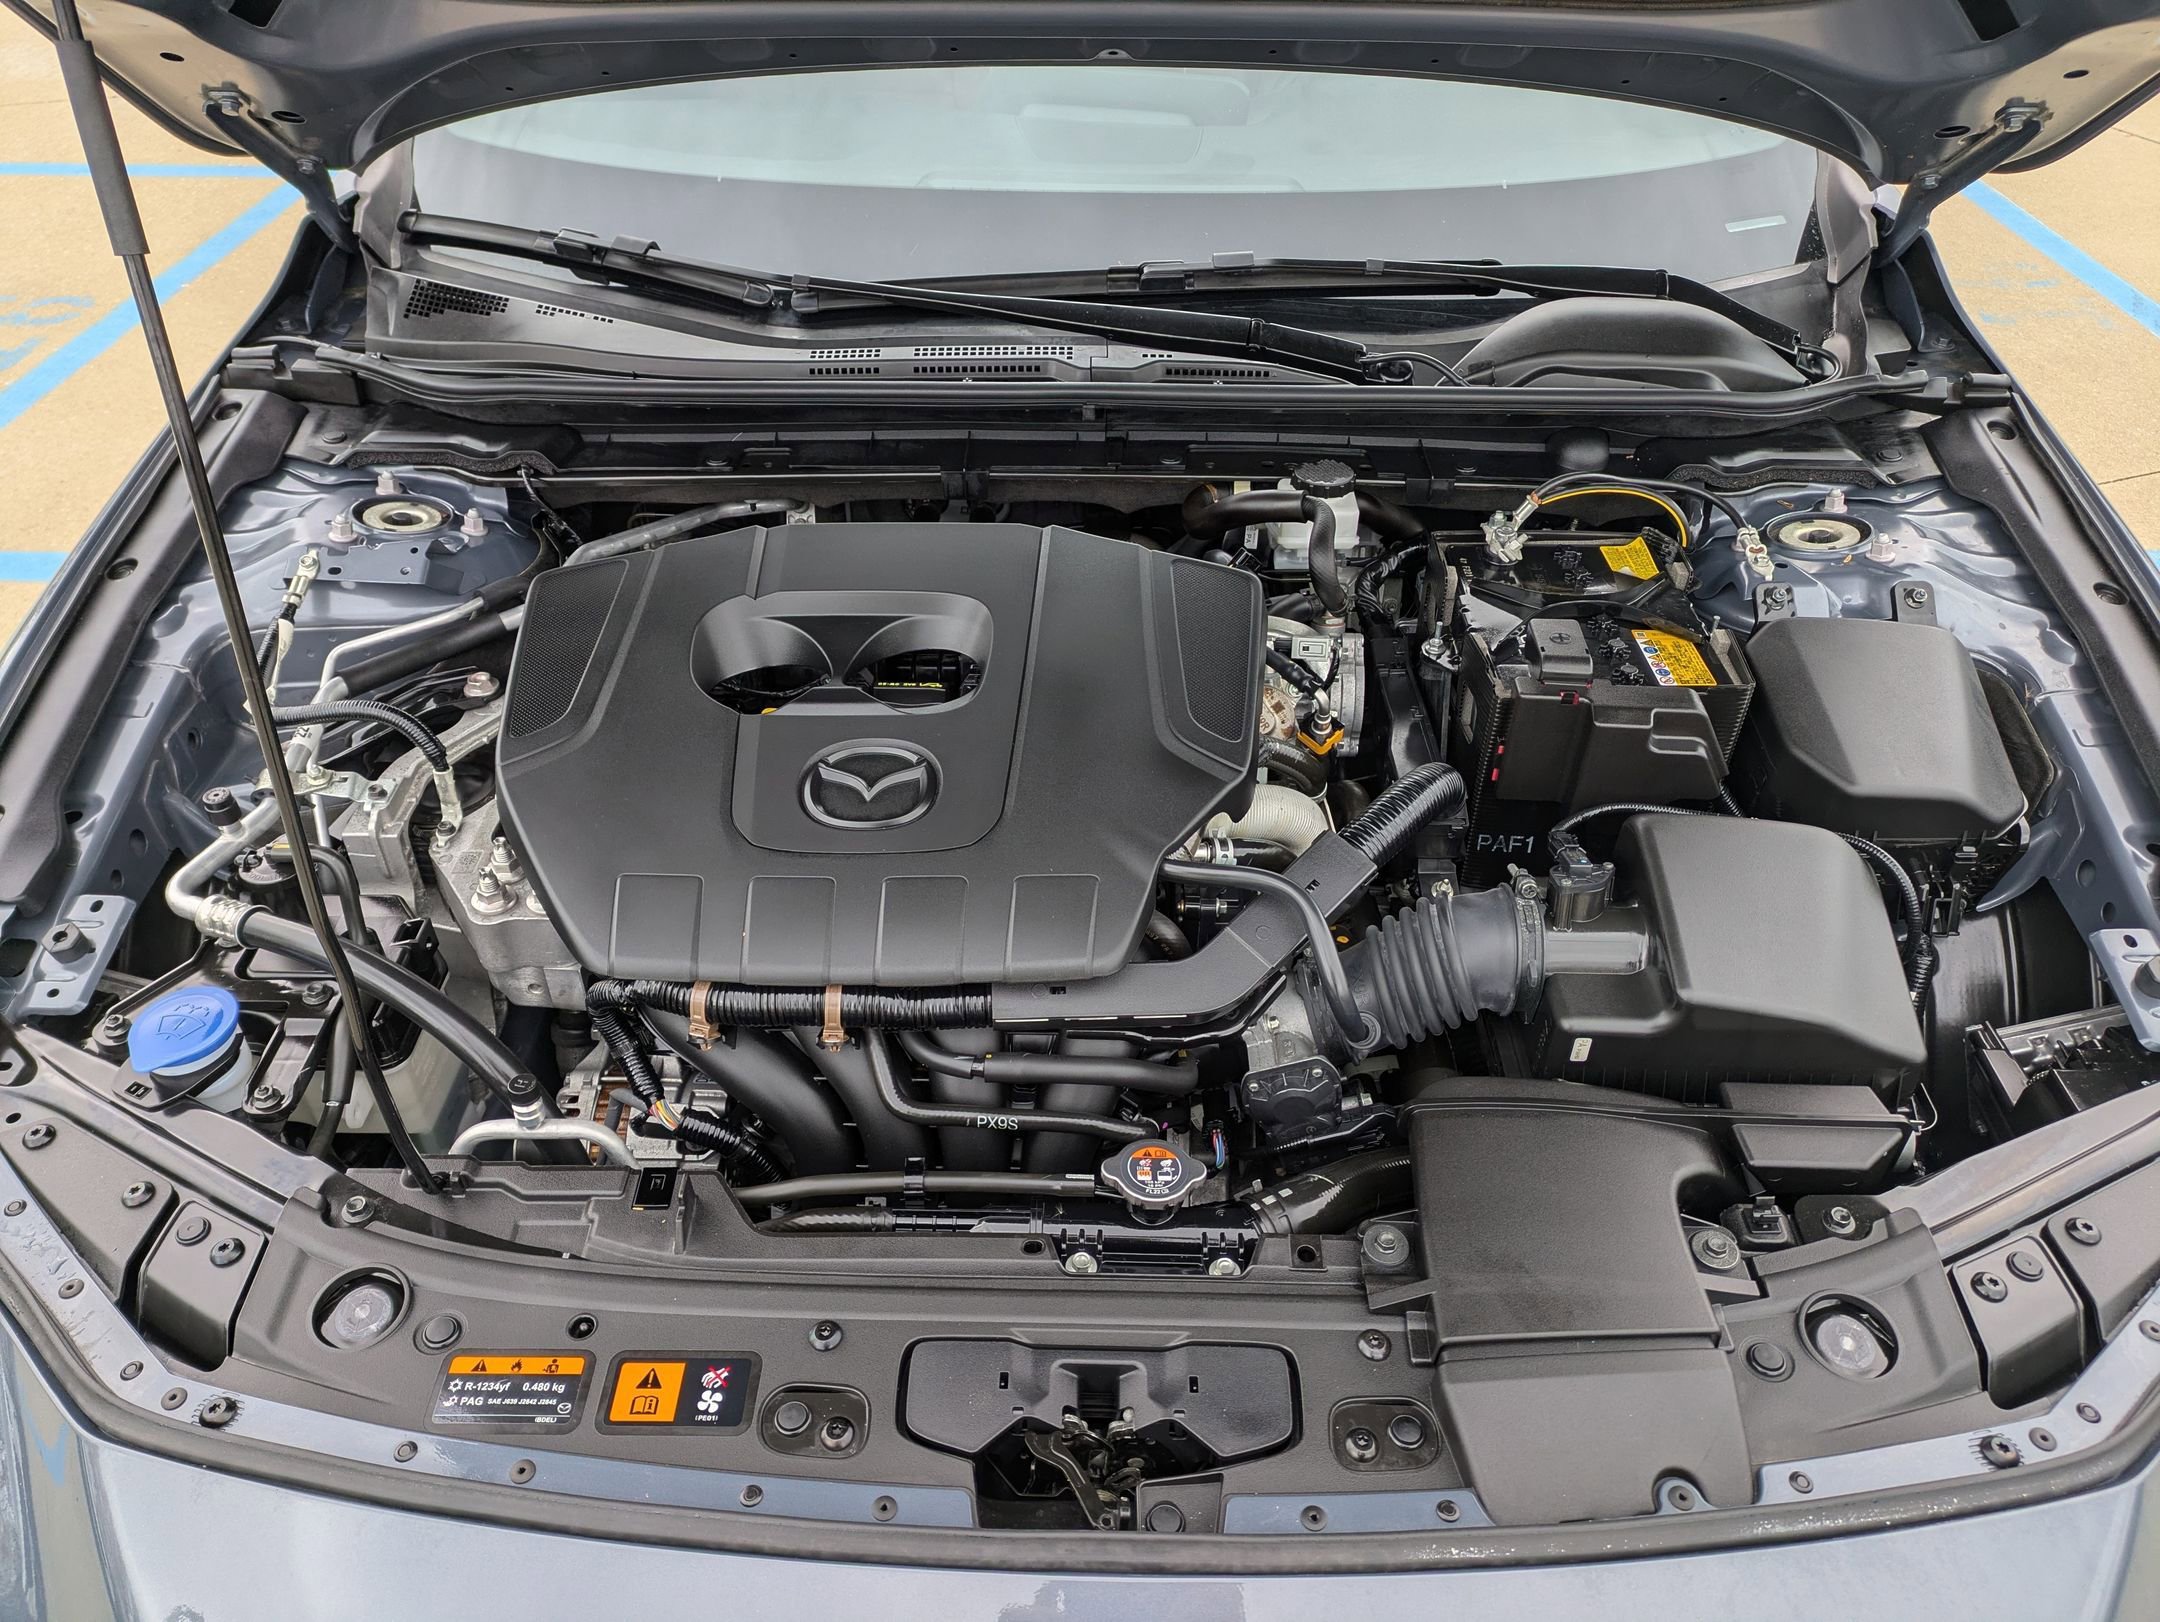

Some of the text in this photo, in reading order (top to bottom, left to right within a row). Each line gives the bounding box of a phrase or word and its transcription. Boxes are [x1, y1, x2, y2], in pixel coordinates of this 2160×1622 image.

[1477, 834, 1534, 854] PAF1
[977, 1115, 1018, 1130] PX9S
[464, 1382, 565, 1393] R-1234yf 0.480 kg
[459, 1397, 484, 1406] PAG
